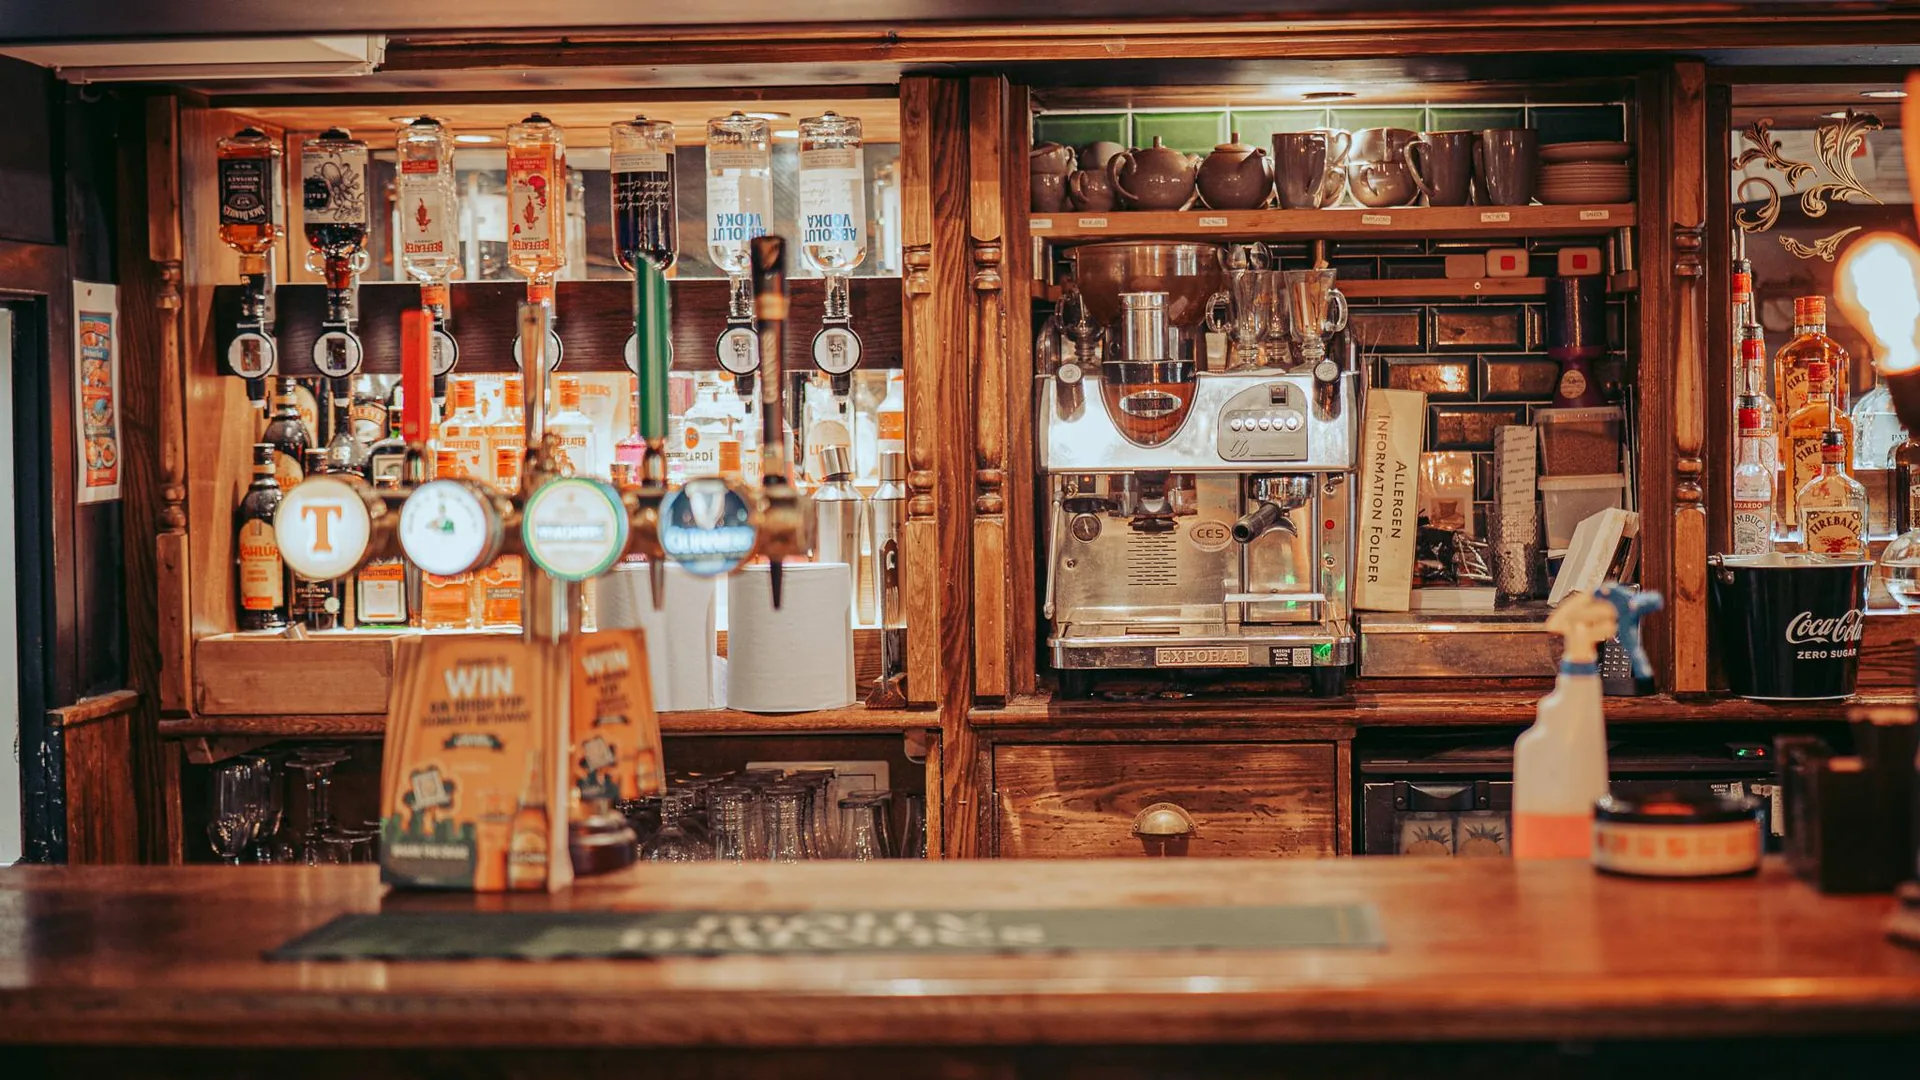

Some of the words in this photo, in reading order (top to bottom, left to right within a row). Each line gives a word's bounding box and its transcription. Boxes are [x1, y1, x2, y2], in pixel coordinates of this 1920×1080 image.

[248, 204, 266, 219] JACK
[716, 213, 762, 228] VODKA
[806, 213, 852, 228] VODKA
[712, 227, 767, 242] ABSOLUT
[803, 227, 858, 243] ABSOLUT
[405, 241, 443, 254] BEEFEATER
[512, 240, 549, 252] BEEFEATER
[1127, 398, 1174, 410] EXPOBAR
[444, 439, 481, 450] BEEFEATER
[559, 436, 587, 447] EFEATER
[686, 448, 714, 461] CARDÍ
[1796, 443, 1819, 462] FIRE
[1371, 414, 1391, 521] INFORMATION
[1390, 460, 1408, 540] ALLERGEN
[301, 505, 342, 553] T
[1734, 514, 1766, 532] AMBUCA
[1809, 516, 1859, 535] FIREBALL
[1197, 528, 1224, 538] CES
[240, 543, 281, 561] KAHLÚA
[1367, 526, 1384, 584] FOLDER
[1785, 608, 1864, 644] Coca-Cola
[1158, 649, 1245, 663] EXPOBAR
[1796, 650, 1828, 660] ZERO
[1830, 648, 1857, 659] SUGAR
[581, 648, 630, 677] WIN
[443, 666, 513, 699] WIN
